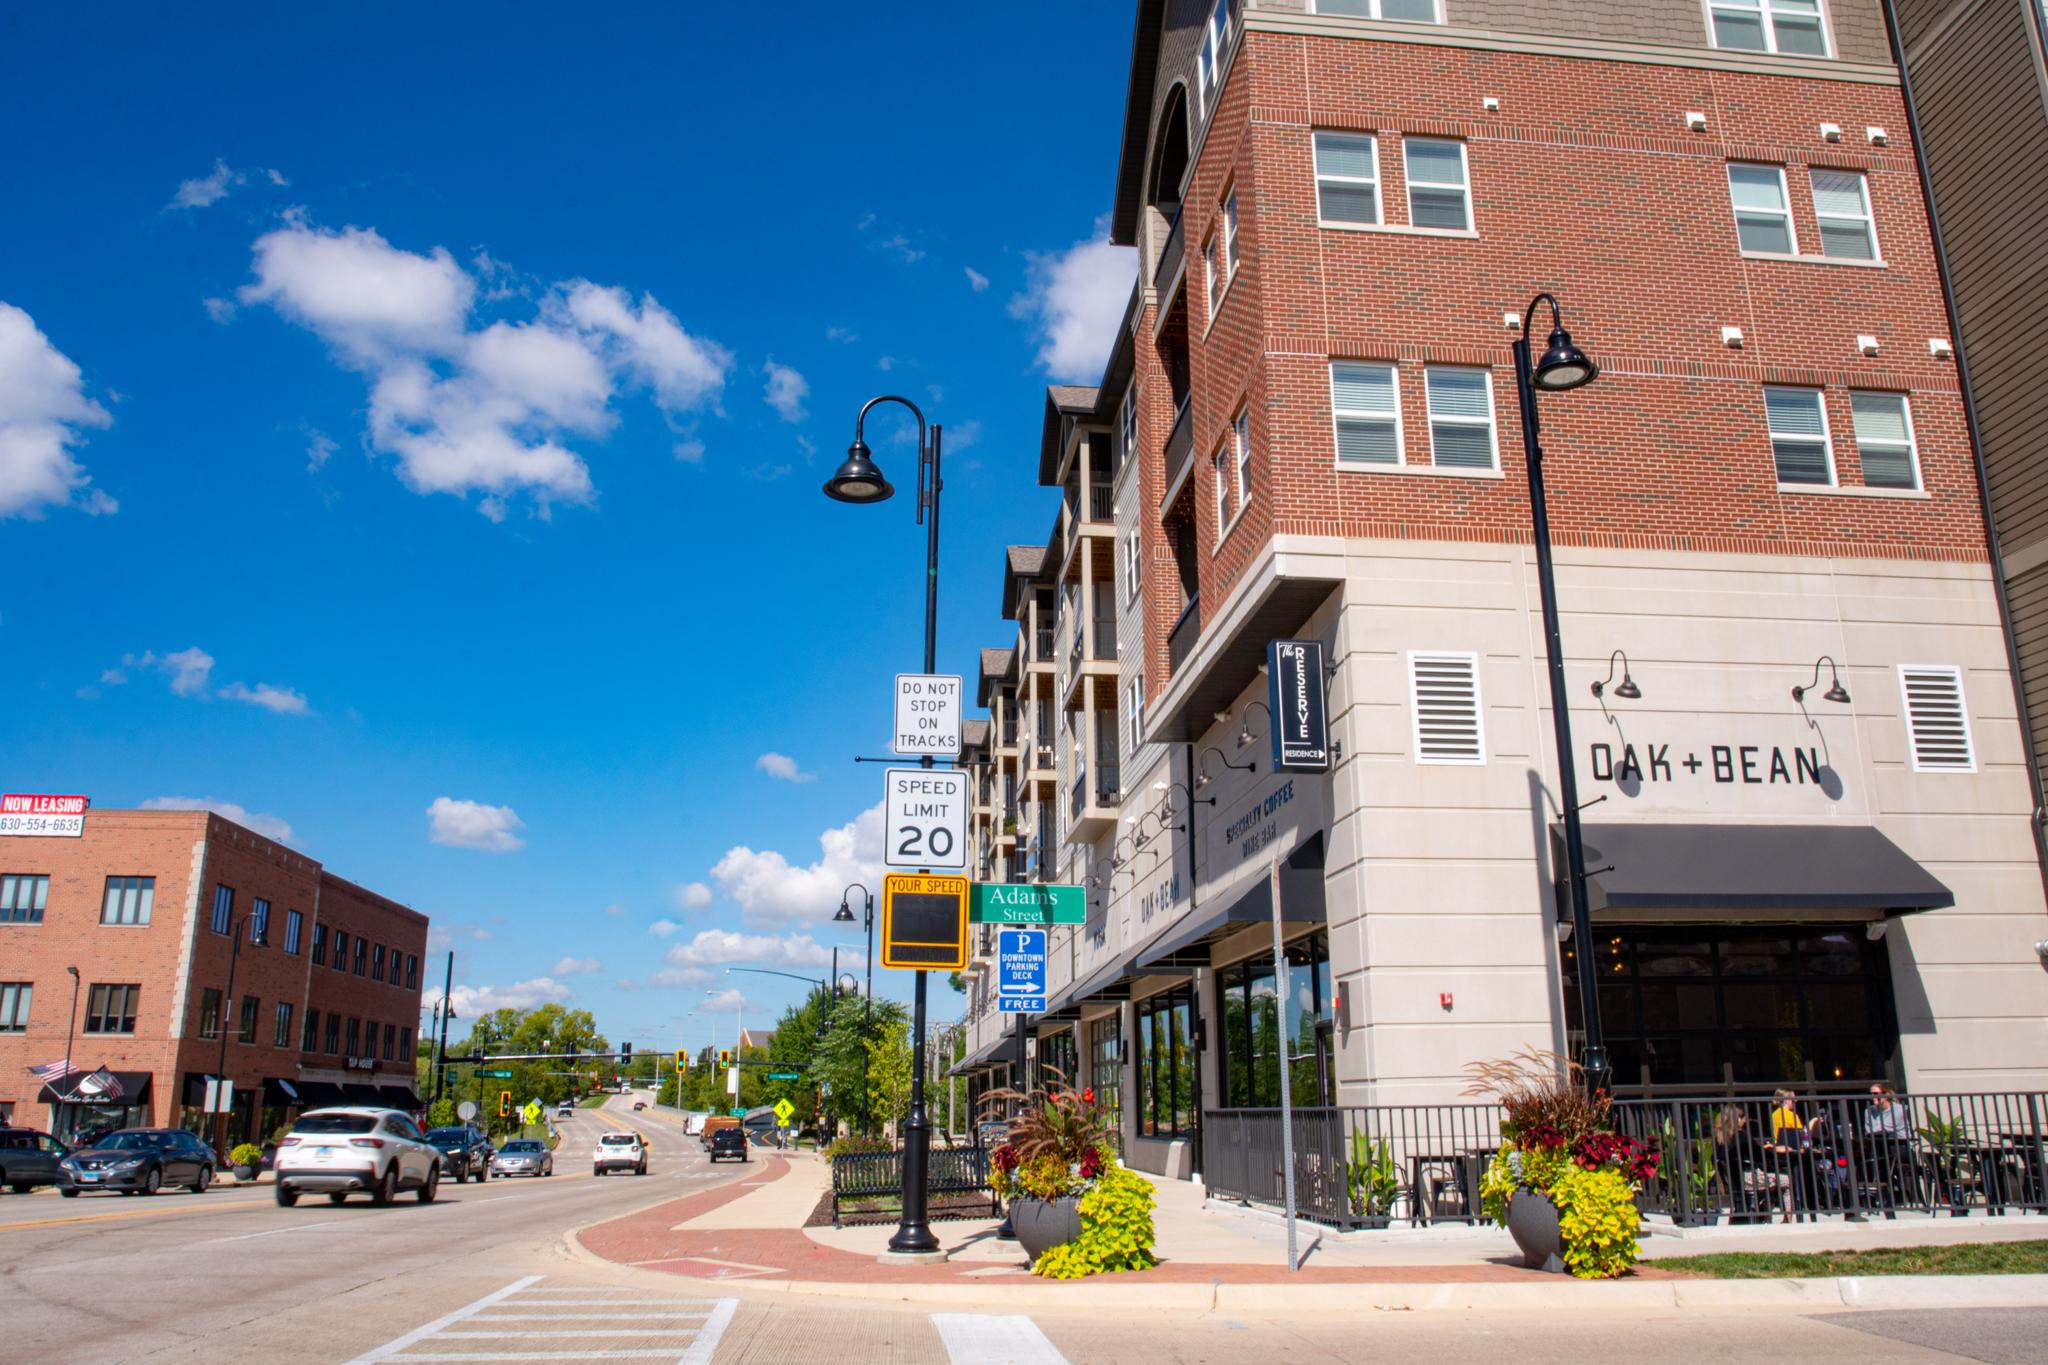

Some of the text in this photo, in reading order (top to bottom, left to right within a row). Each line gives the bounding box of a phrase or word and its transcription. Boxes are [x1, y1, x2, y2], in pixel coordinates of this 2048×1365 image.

[1280, 644, 1295, 658] The
[902, 682, 956, 696] DO NOT
[1295, 646, 1309, 738] RESERVE
[911, 700, 947, 712] STOP
[918, 717, 938, 729] ON
[899, 734, 956, 747] TRACKS
[1285, 749, 1318, 758] RESIDENCE
[1590, 743, 1821, 785] OAK + BEAN
[897, 780, 957, 795] SPEED
[3, 796, 84, 813] NOW LEASING
[903, 803, 949, 818] LIMIT
[1226, 779, 1294, 845] SPECIALTY COFFEE
[0, 817, 80, 832] 630-554-6635
[897, 825, 954, 858] 20
[890, 878, 963, 894] YOUR SPEED
[989, 887, 1059, 906] Adams
[1003, 908, 1045, 921] Street
[1016, 934, 1031, 953] P
[1002, 953, 1044, 963] DOWNTOWN
[1005, 963, 1039, 971] PARKING
[1012, 971, 1033, 980] DECK
[1004, 1000, 1040, 1009] FREE
